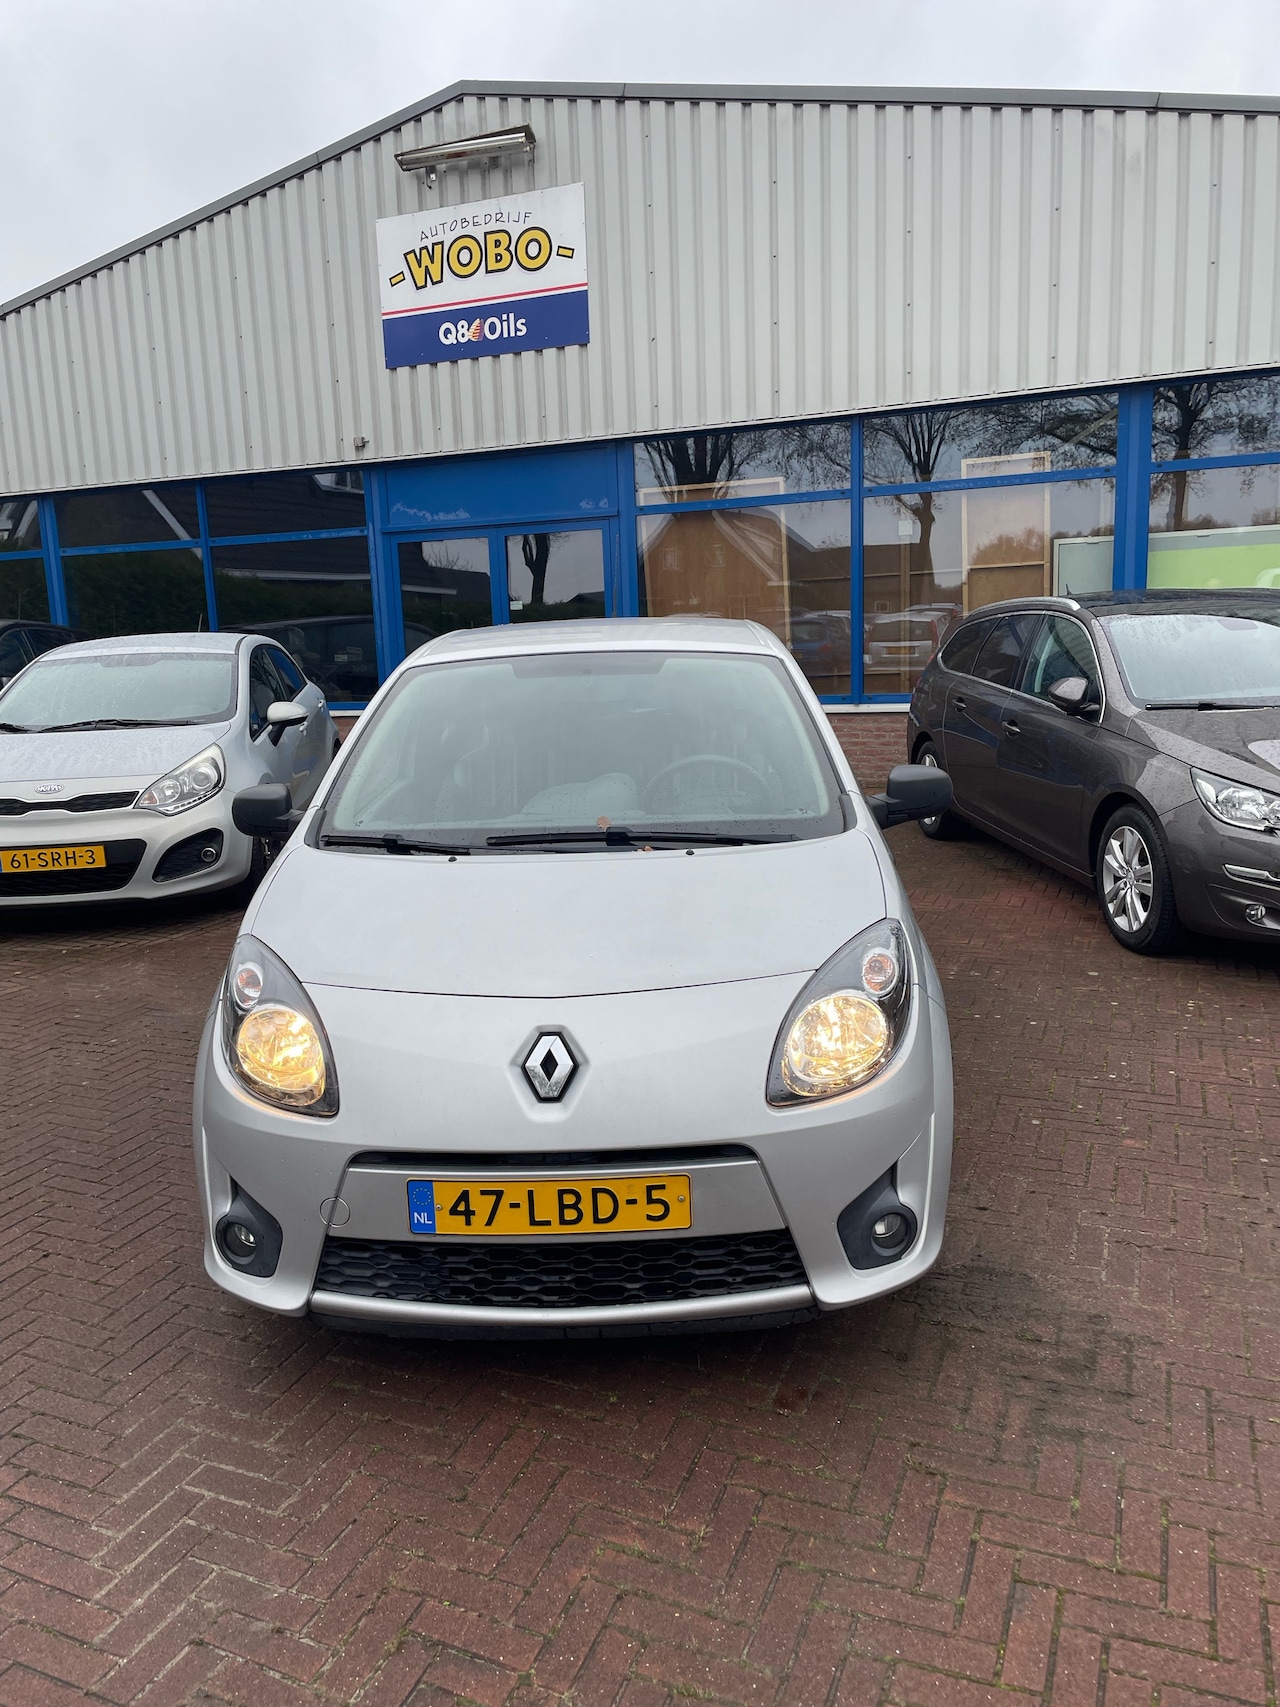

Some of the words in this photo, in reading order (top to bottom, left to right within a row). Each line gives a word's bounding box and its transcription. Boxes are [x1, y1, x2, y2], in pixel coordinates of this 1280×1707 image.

[419, 211, 533, 242] AUTOBEDRIJF
[438, 320, 470, 345] Q8
[484, 312, 527, 340] Oils
[10, 849, 96, 869] 61-SRH-3
[413, 1212, 432, 1224] NL
[448, 1183, 671, 1227] 47-LBD-5
